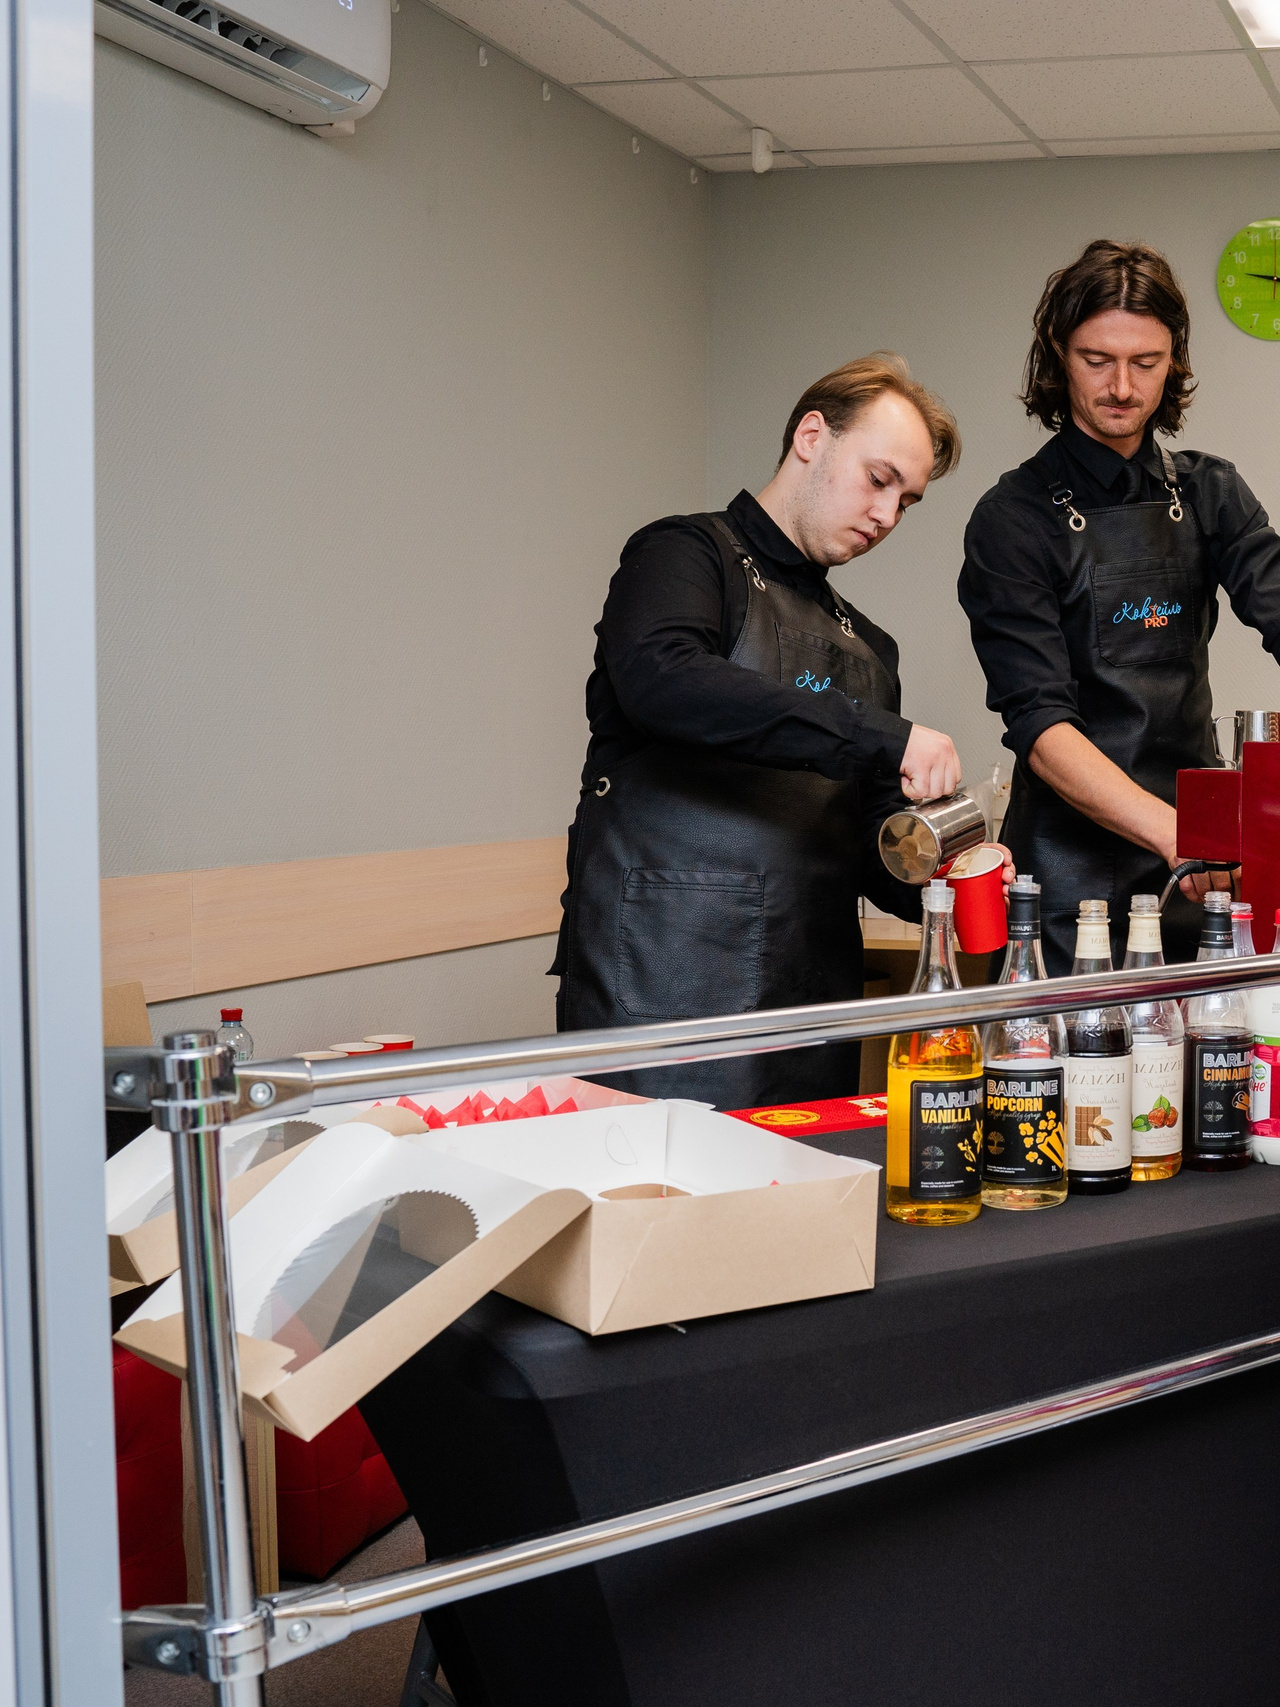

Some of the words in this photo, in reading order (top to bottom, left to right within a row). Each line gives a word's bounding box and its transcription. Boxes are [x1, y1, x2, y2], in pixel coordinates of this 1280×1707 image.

[1249, 234, 1260, 246] 11
[1233, 251, 1246, 264] 10
[1227, 275, 1235, 287] 9
[1233, 297, 1242, 309] 8
[1251, 313, 1260, 326] 7
[1273, 318, 1280, 331] 6
[1144, 615, 1168, 629] PRO
[986, 1079, 1059, 1097] BARLINE
[920, 1086, 984, 1109] BARLIN
[986, 1095, 1043, 1112] POPCORN
[1079, 1093, 1119, 1106] Chocolate
[920, 1107, 971, 1124] VANILLA
